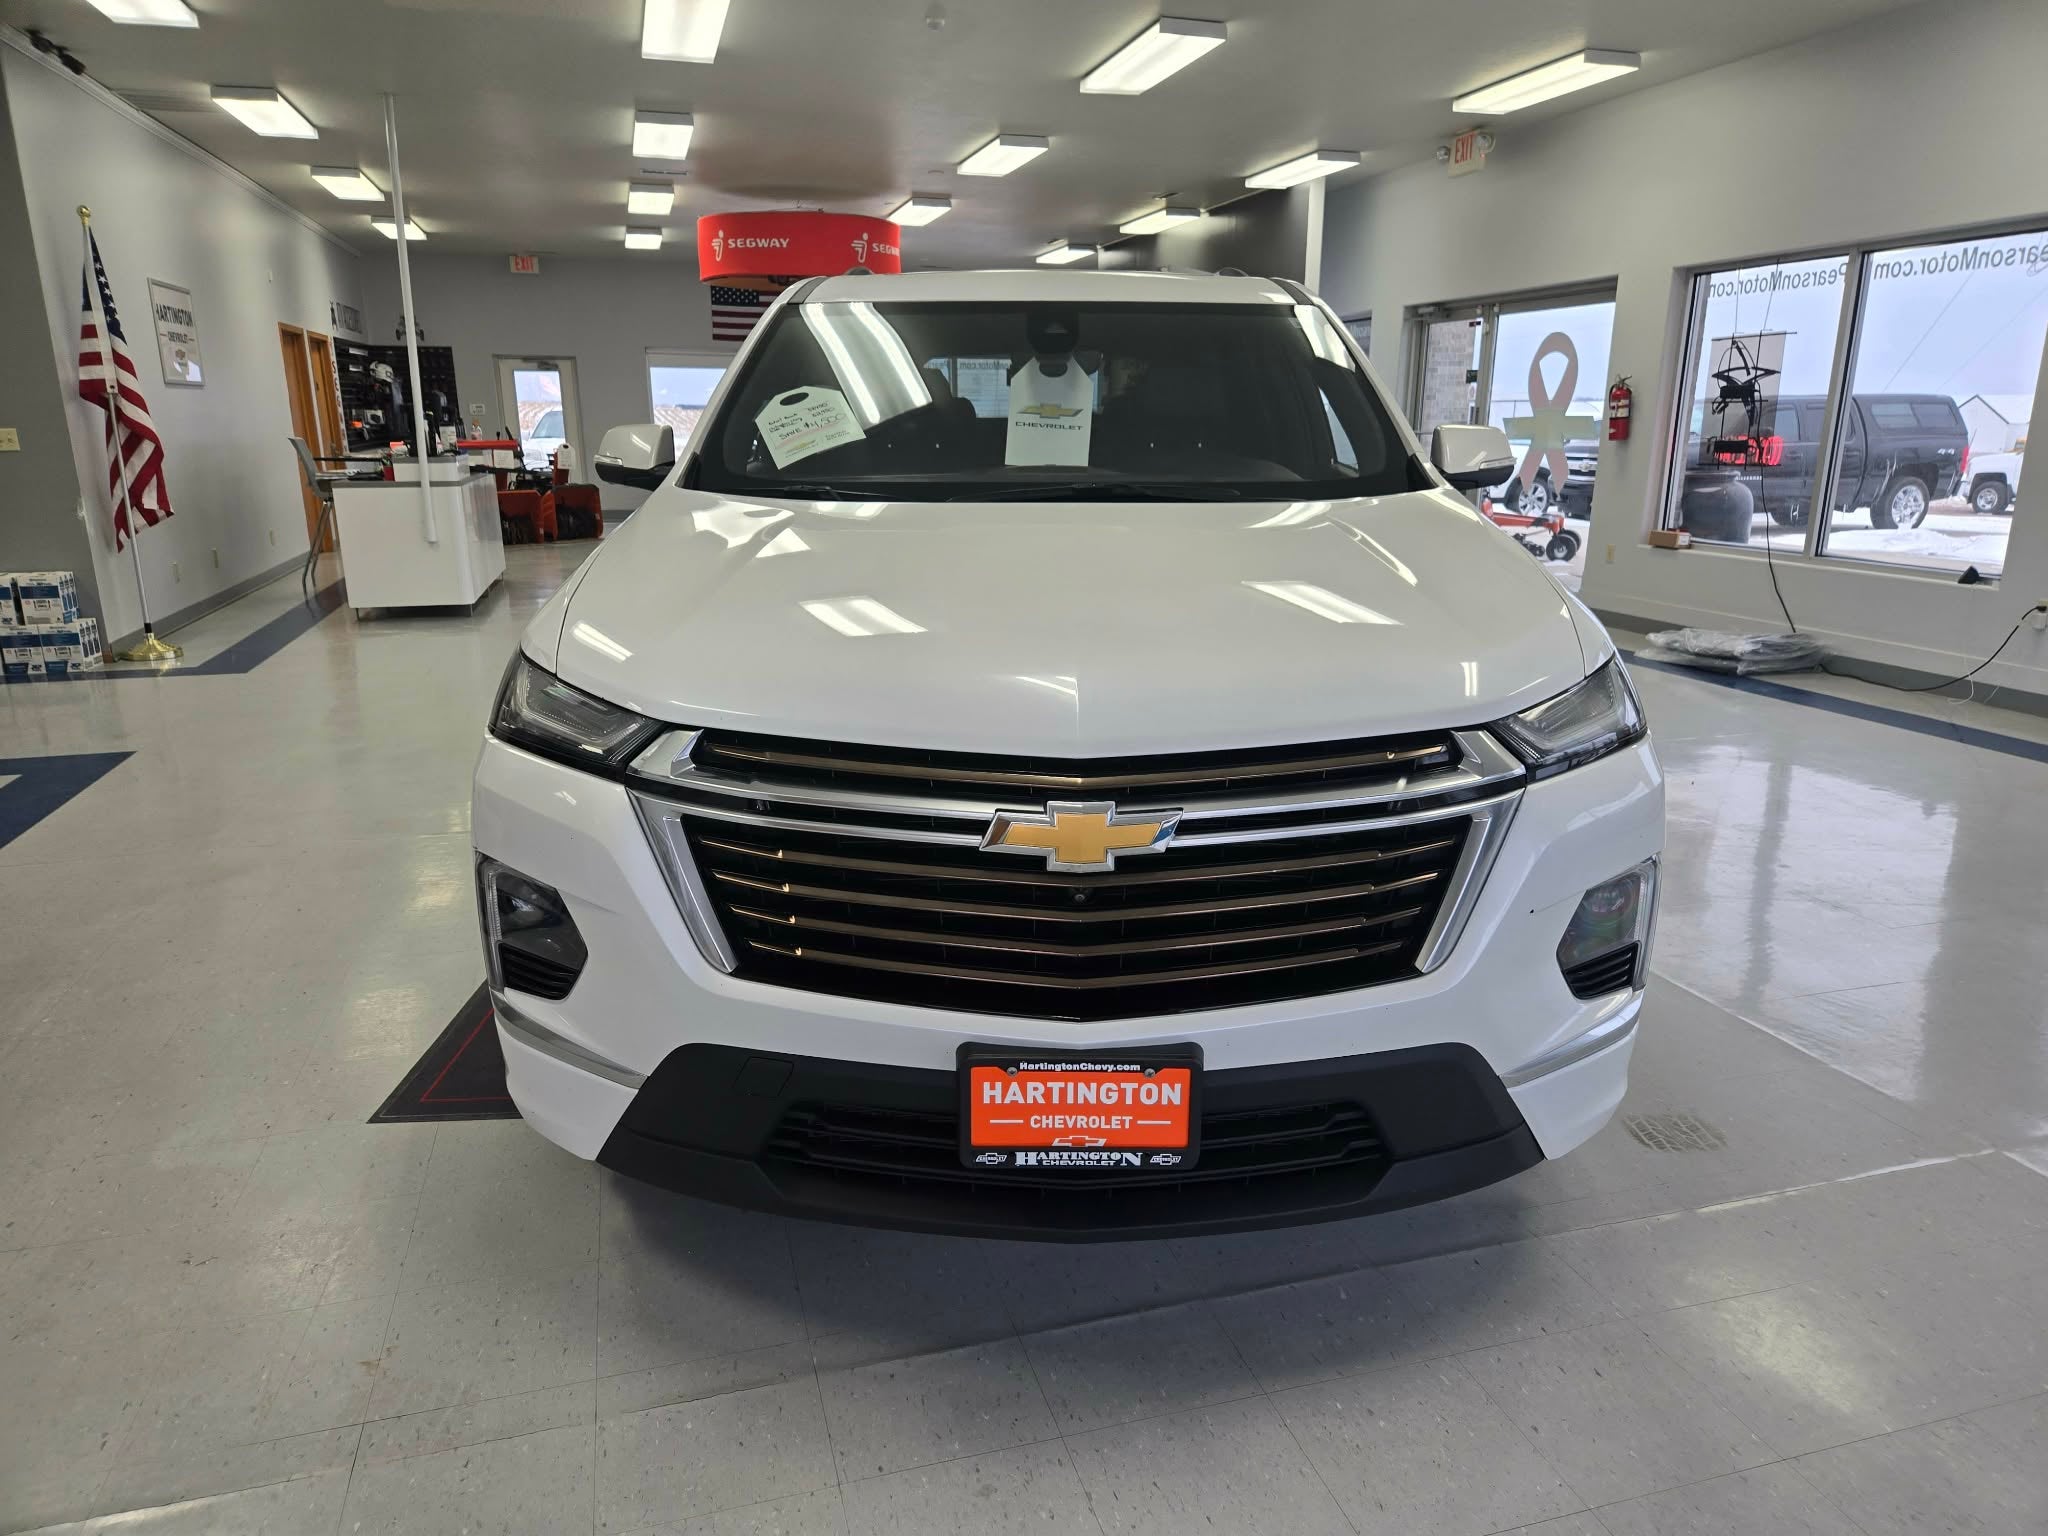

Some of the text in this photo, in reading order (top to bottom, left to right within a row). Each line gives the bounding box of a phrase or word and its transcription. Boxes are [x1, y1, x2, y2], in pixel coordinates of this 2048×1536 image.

[1455, 133, 1475, 164] EXIT
[727, 237, 790, 248] SEGWAY
[514, 255, 534, 271] EXIT
[1015, 421, 1084, 431] CHEVROLET
[1019, 1061, 1141, 1072] HartingtonChevy.com
[983, 1081, 1182, 1105] HARTINGTON
[1030, 1115, 1133, 1129] CHEVROLET
[1014, 1151, 1144, 1167] HARTINGTON
